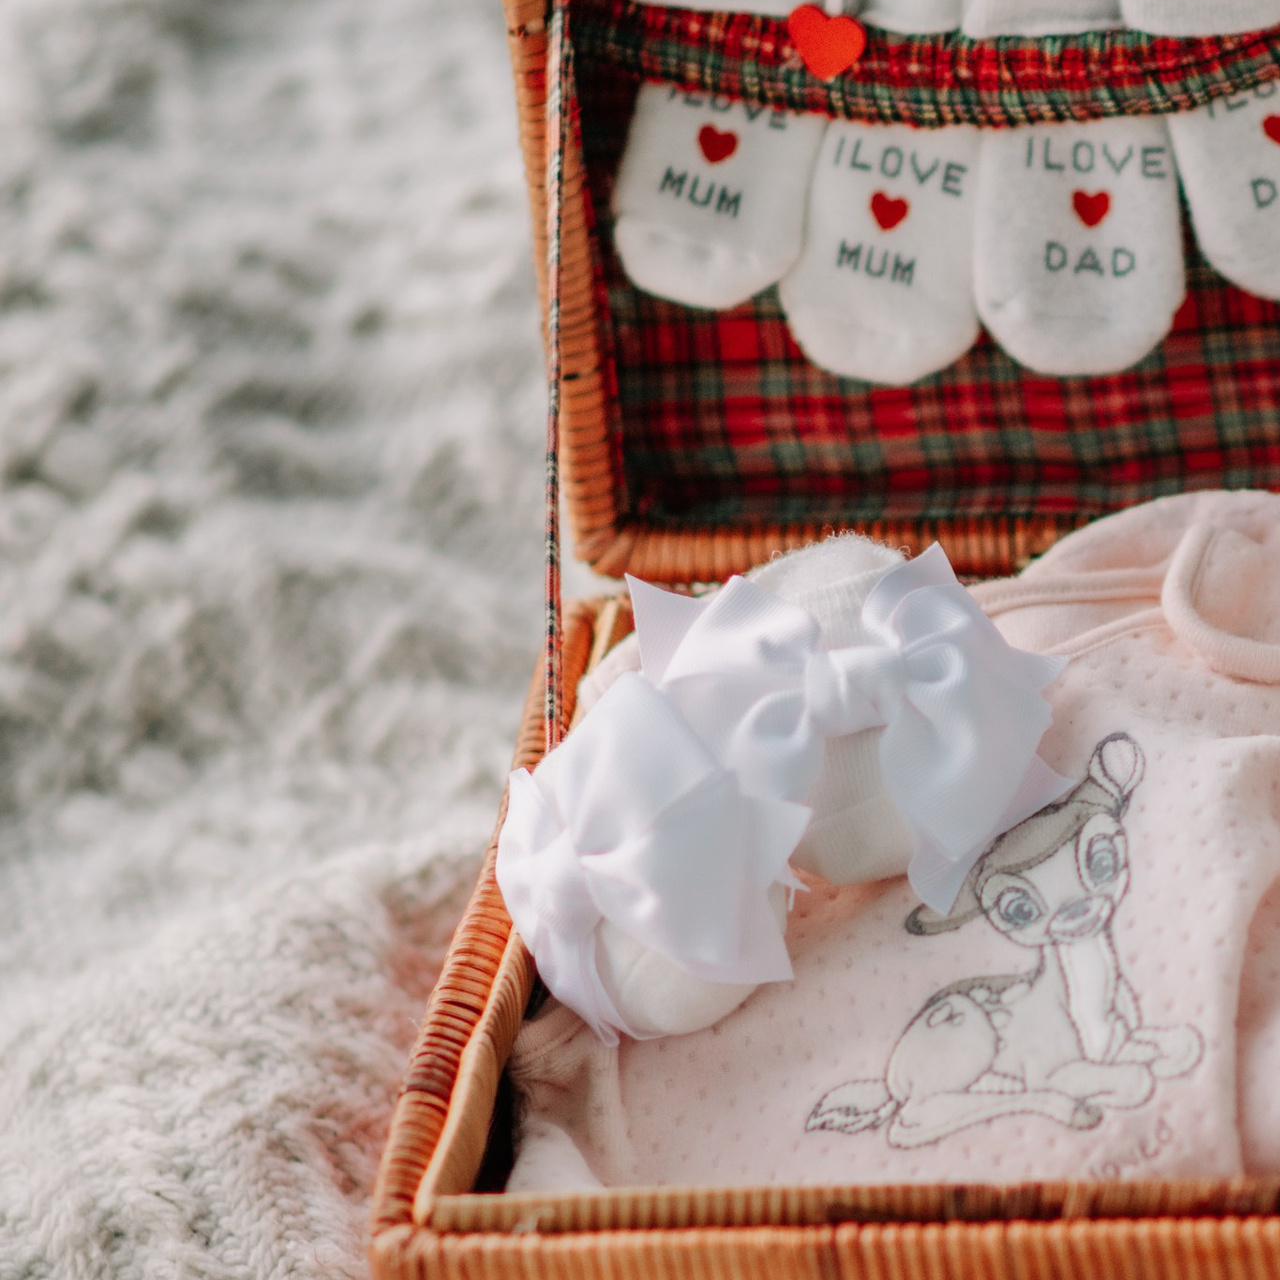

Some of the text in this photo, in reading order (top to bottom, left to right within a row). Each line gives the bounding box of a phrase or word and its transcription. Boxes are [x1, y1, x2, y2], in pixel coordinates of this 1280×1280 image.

[658, 166, 744, 218] MUM
[836, 239, 917, 287] MUM
[1044, 240, 1136, 278] DAD
